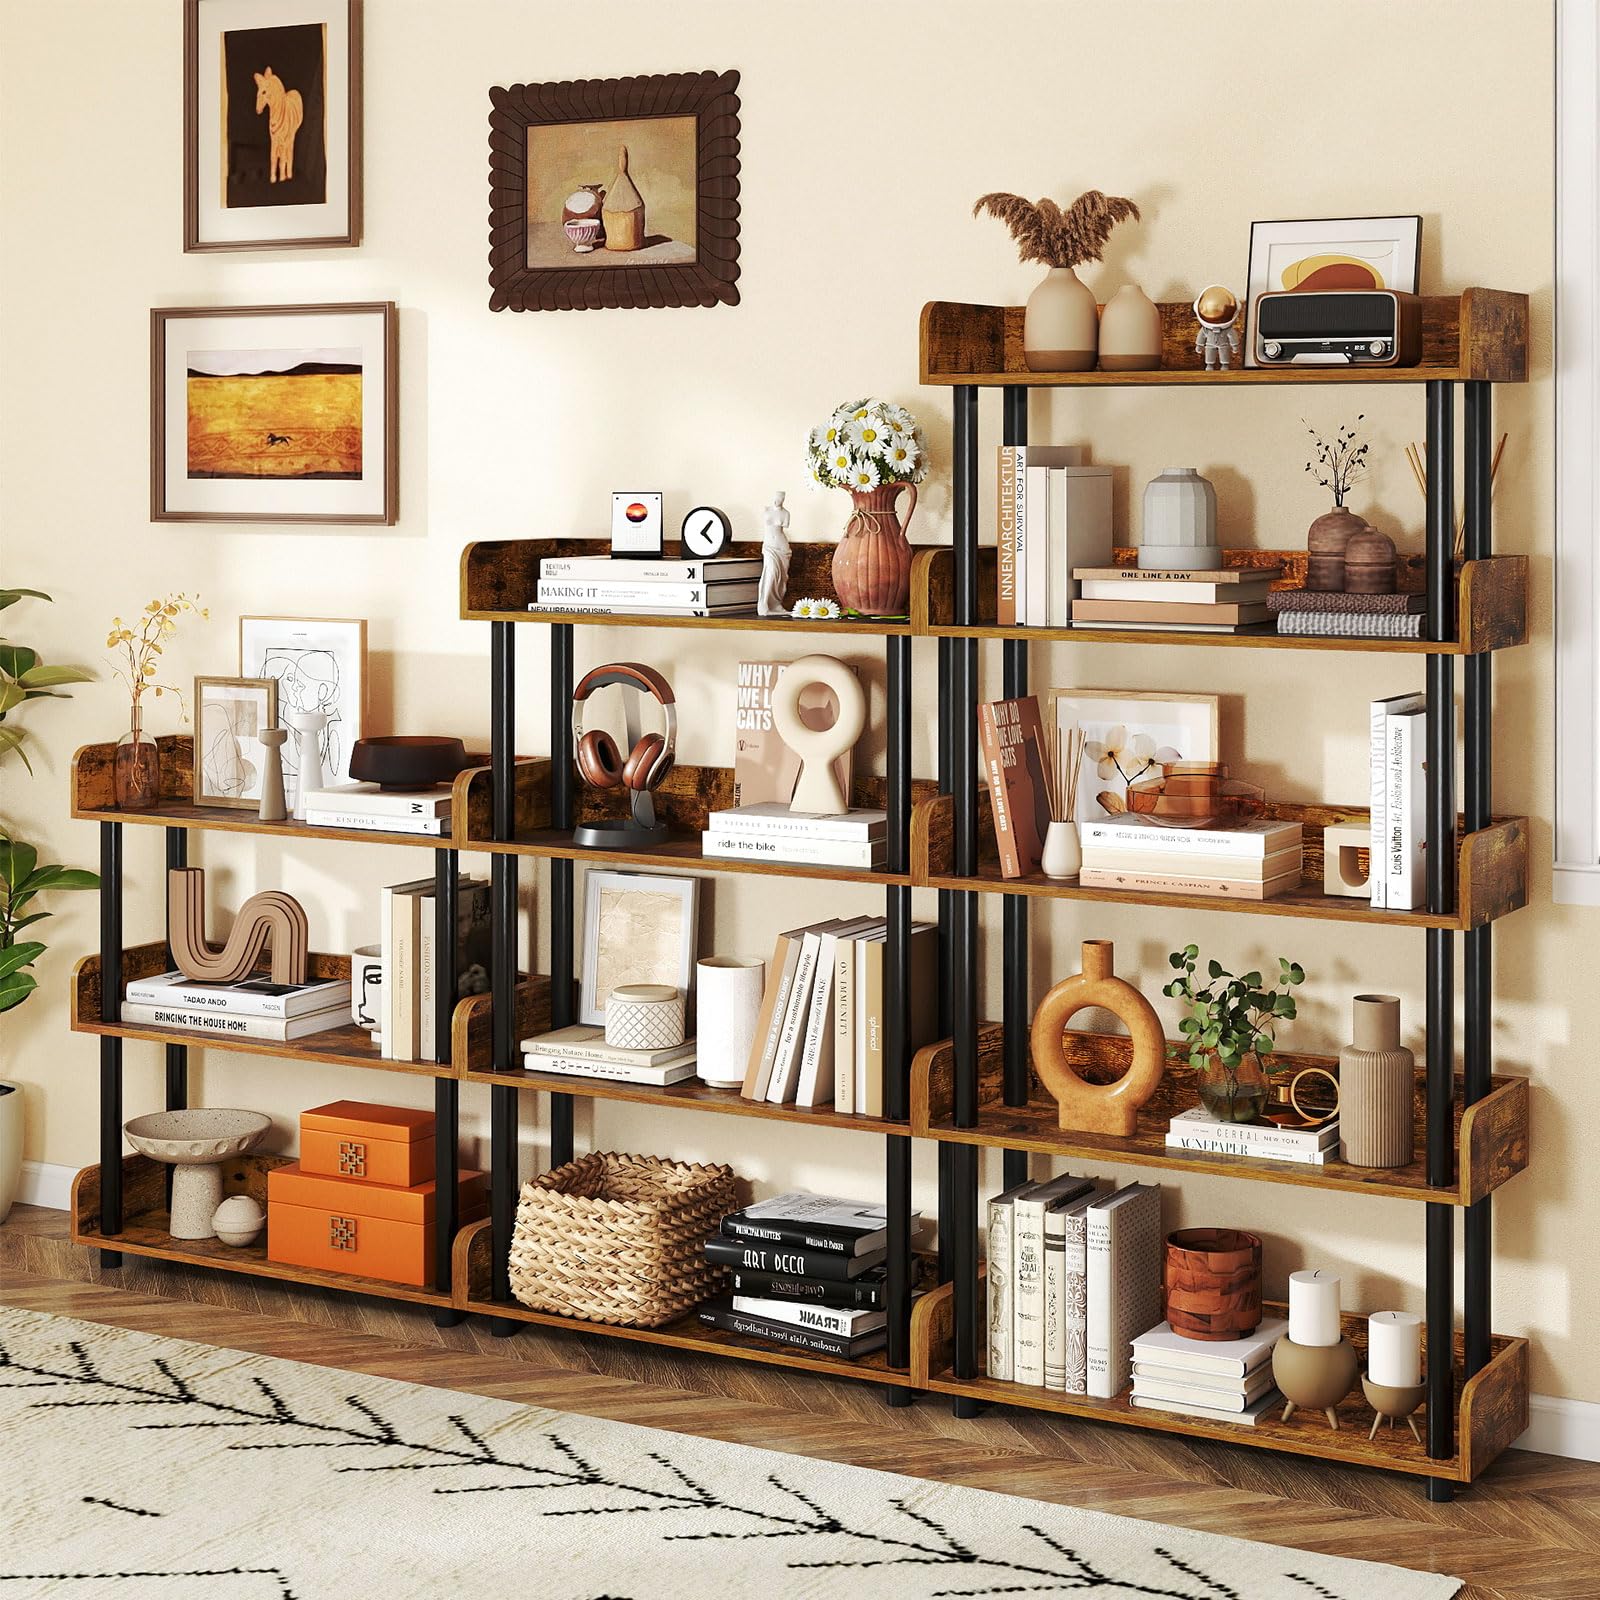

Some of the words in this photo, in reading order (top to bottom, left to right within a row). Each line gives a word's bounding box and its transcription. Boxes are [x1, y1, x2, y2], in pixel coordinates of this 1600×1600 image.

[1016, 453, 1024, 474] ART
[1016, 477, 1024, 500] FOR
[1001, 446, 1013, 600] INNENARCHITEKTUR
[1016, 503, 1024, 553] SURVIVAL
[1143, 572, 1162, 580] LINE
[540, 586, 584, 598] MAKING
[587, 588, 598, 598] IT
[739, 664, 773, 687] WHY
[738, 687, 761, 709] WE
[737, 709, 772, 731] CATS
[991, 760, 999, 776] WHY
[993, 776, 1000, 787] DO
[995, 786, 1003, 798] WE
[996, 797, 1005, 815] LOVE
[336, 816, 377, 825] KINFOLK
[999, 814, 1008, 832] CATS
[718, 839, 736, 849] ride
[739, 841, 754, 850] the
[756, 842, 776, 852] bike
[1391, 826, 1403, 853] Vuitton
[1391, 854, 1403, 876] Louis
[1135, 878, 1168, 886] PRINCE
[1171, 881, 1211, 889] CASPIAN
[840, 961, 847, 975] ON
[183, 995, 206, 1005] TADAO
[207, 998, 227, 1007] ANDO
[785, 1033, 793, 1044] for
[789, 983, 805, 1025] sustainable
[799, 953, 812, 983] lifestyle
[839, 981, 848, 1037] IMMUNITY
[154, 1011, 187, 1025] BRINGING
[189, 1015, 202, 1027] THE
[203, 1017, 226, 1029] HOUSE
[227, 1020, 247, 1032] HOME
[764, 1043, 774, 1061] THIS
[773, 1001, 784, 1025] GOOD
[779, 975, 790, 1000] GUIDE
[806, 1034, 818, 1066] DREAM
[816, 977, 827, 1008] AWAKE
[868, 1016, 880, 1051] spherical
[1216, 1127, 1259, 1142] CEREAL
[1281, 1137, 1300, 1145] YORK
[742, 1249, 767, 1270] ART
[774, 1253, 805, 1275] DECO
